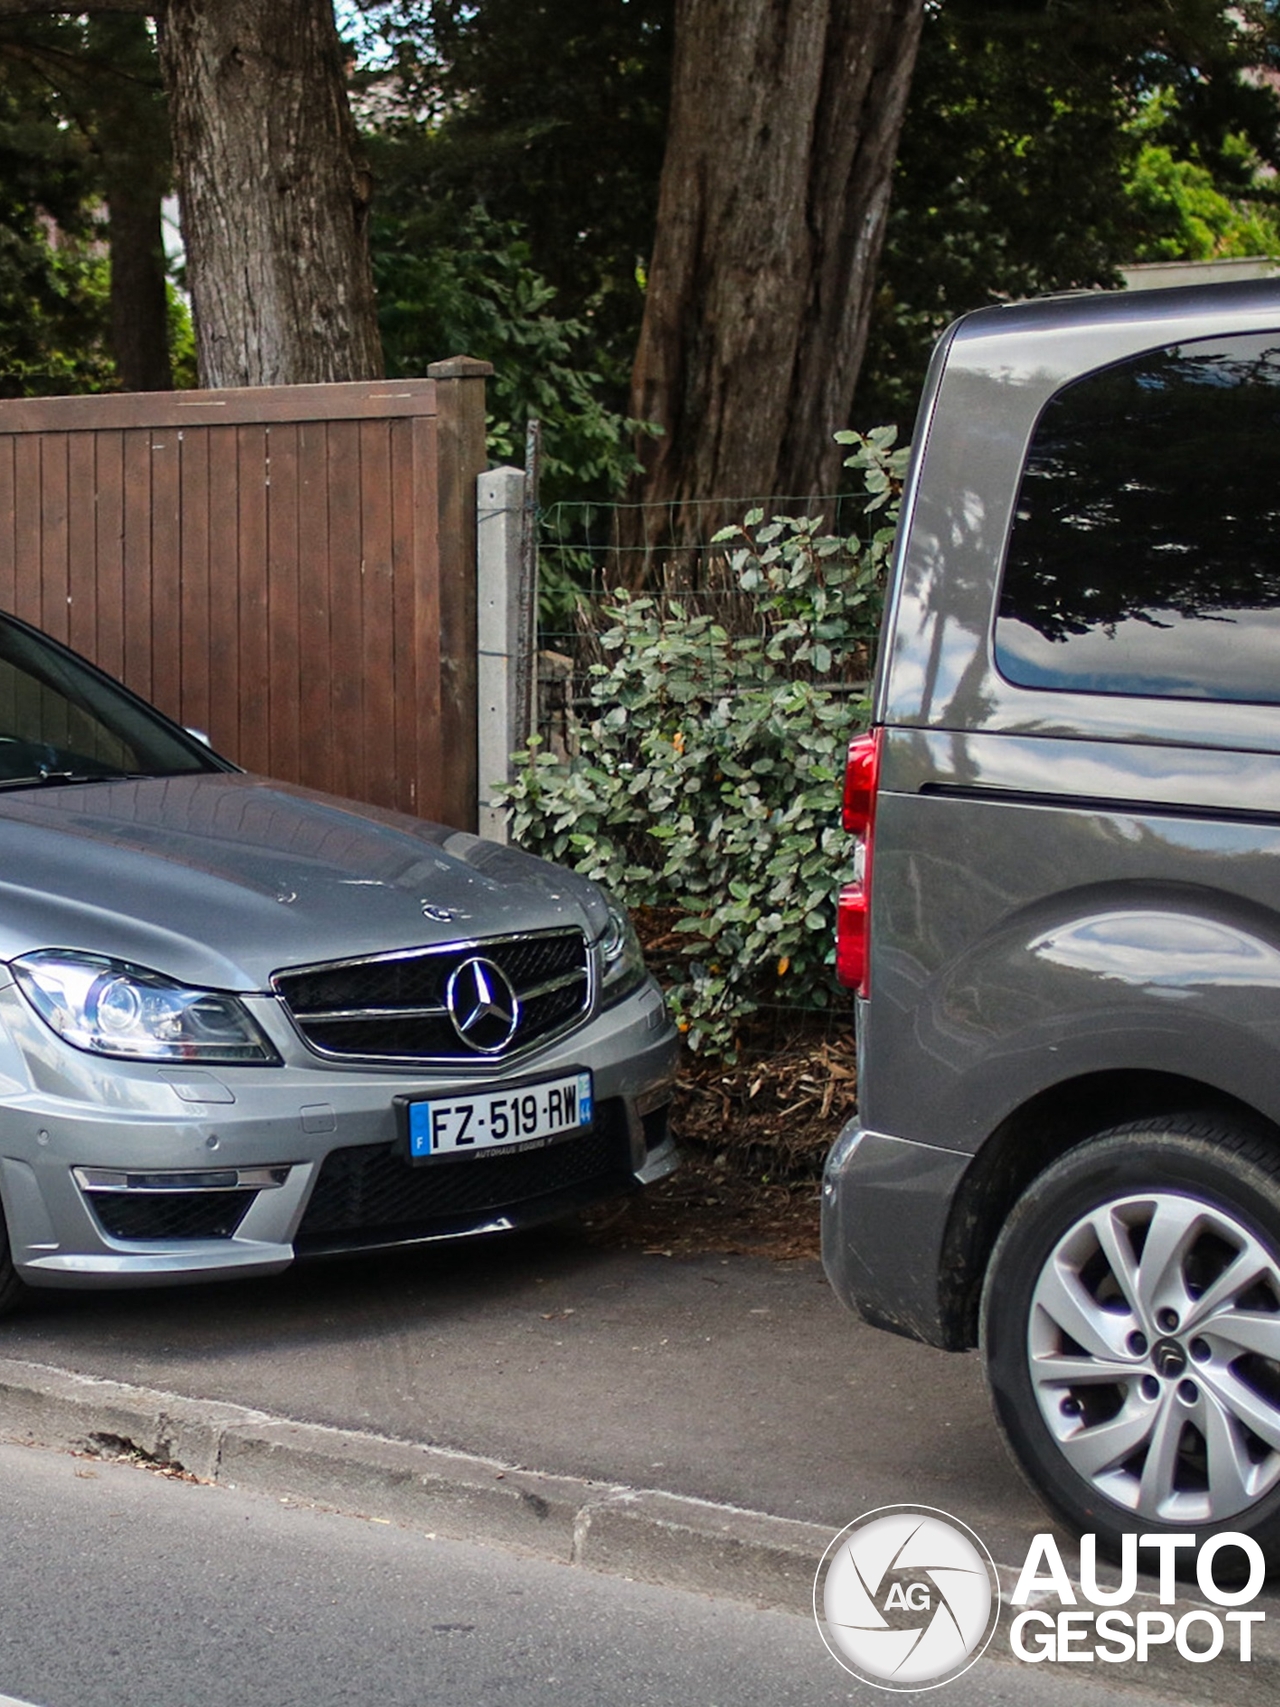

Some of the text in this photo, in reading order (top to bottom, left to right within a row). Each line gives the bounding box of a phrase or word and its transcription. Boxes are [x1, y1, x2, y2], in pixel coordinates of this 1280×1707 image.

[432, 1085, 576, 1149] FZ-519-RW
[416, 1137, 423, 1150] F
[474, 1146, 515, 1159] AUTOHAUS
